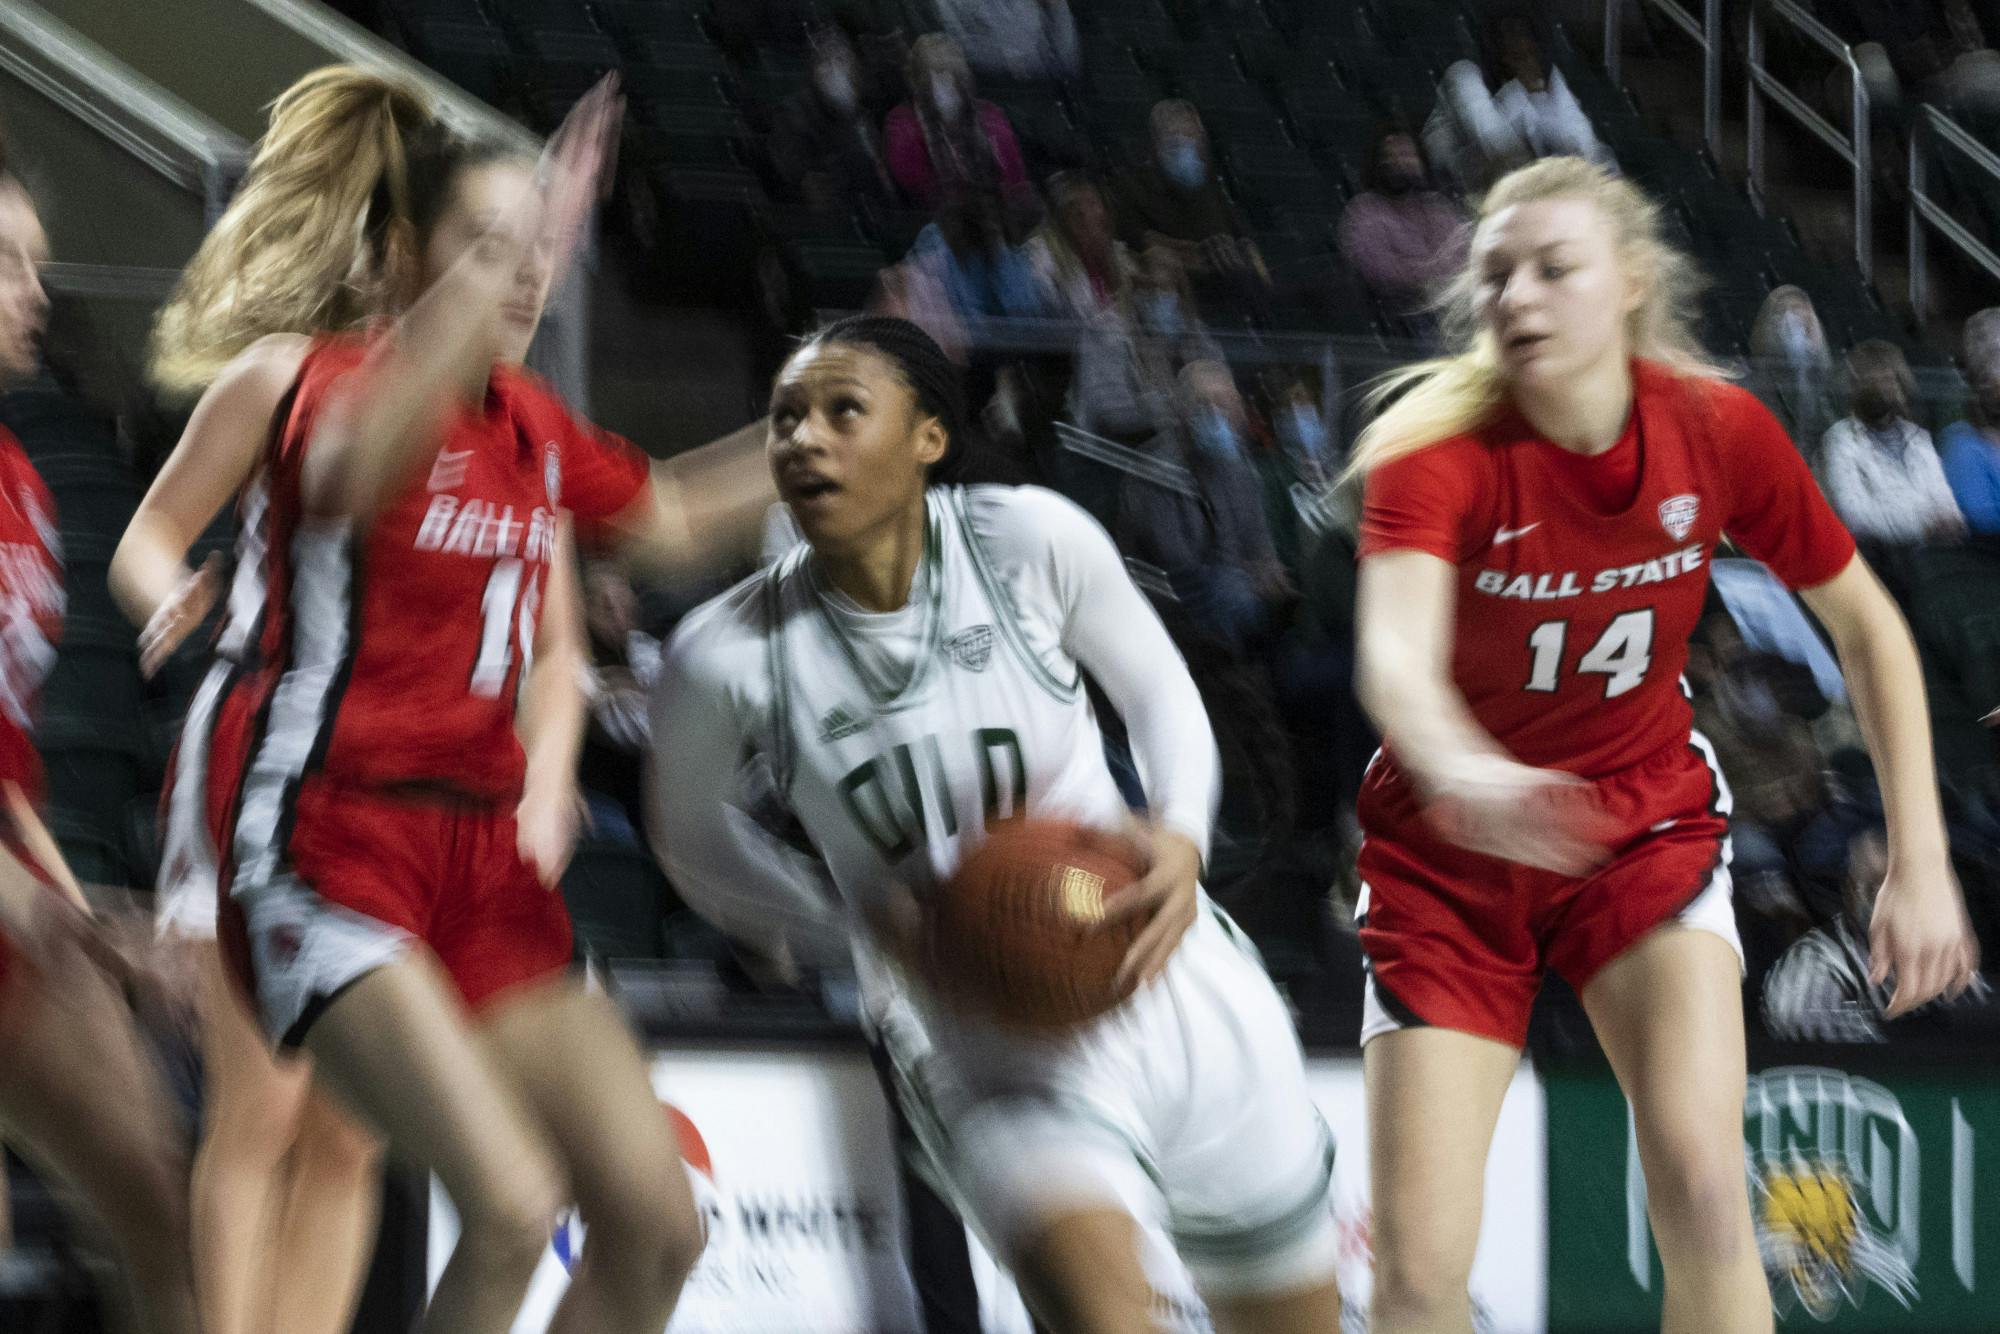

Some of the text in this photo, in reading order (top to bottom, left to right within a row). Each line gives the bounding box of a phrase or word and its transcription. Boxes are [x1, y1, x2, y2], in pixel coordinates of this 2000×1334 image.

[1474, 543, 1705, 601] BALL STATE
[1522, 606, 1654, 699] 14
